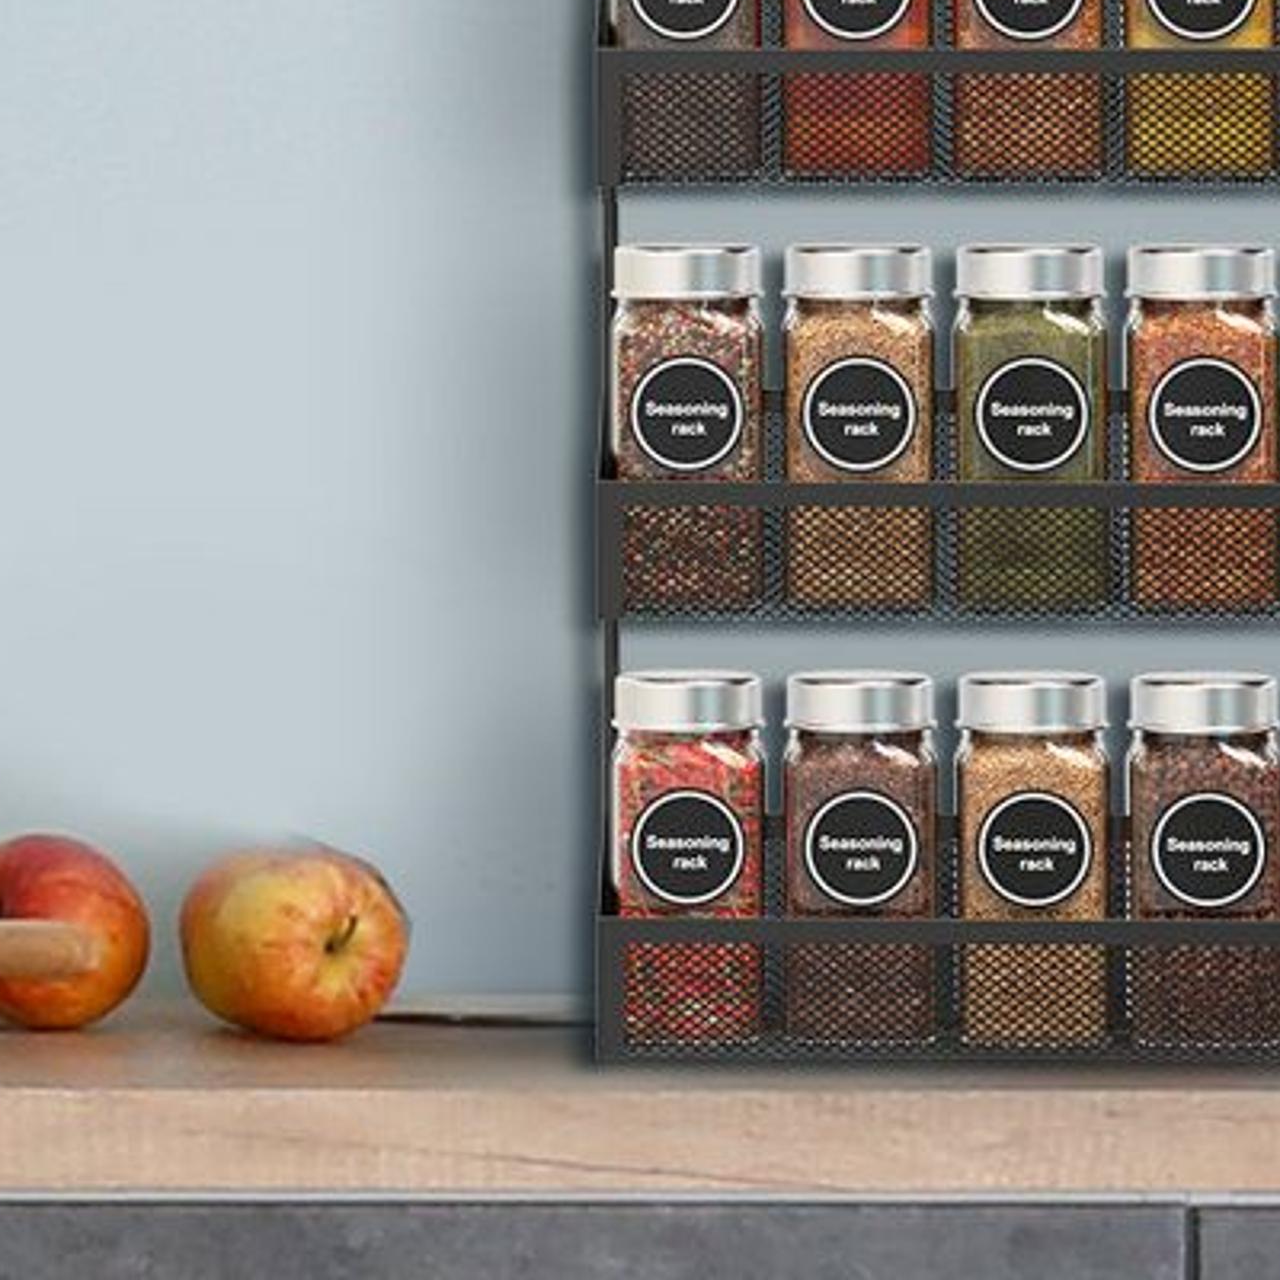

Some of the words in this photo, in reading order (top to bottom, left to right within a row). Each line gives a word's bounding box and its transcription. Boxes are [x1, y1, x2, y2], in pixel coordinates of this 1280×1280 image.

[645, 400, 729, 420] Seasoning
[817, 400, 901, 420] Seasoning
[990, 401, 1075, 420] Seasoning
[1163, 401, 1248, 421] Seasoning
[671, 421, 707, 436] rack
[843, 421, 880, 436] rack
[1016, 421, 1052, 436] rack
[1189, 421, 1226, 437] rack
[646, 834, 730, 853] Seasoning
[818, 834, 904, 854] Seasoning
[993, 835, 1078, 854] Seasoning
[1166, 836, 1251, 856] Seasoning
[672, 854, 708, 870] rack
[845, 856, 881, 871] rack
[1019, 856, 1055, 871] rack
[1193, 857, 1229, 872] rack
